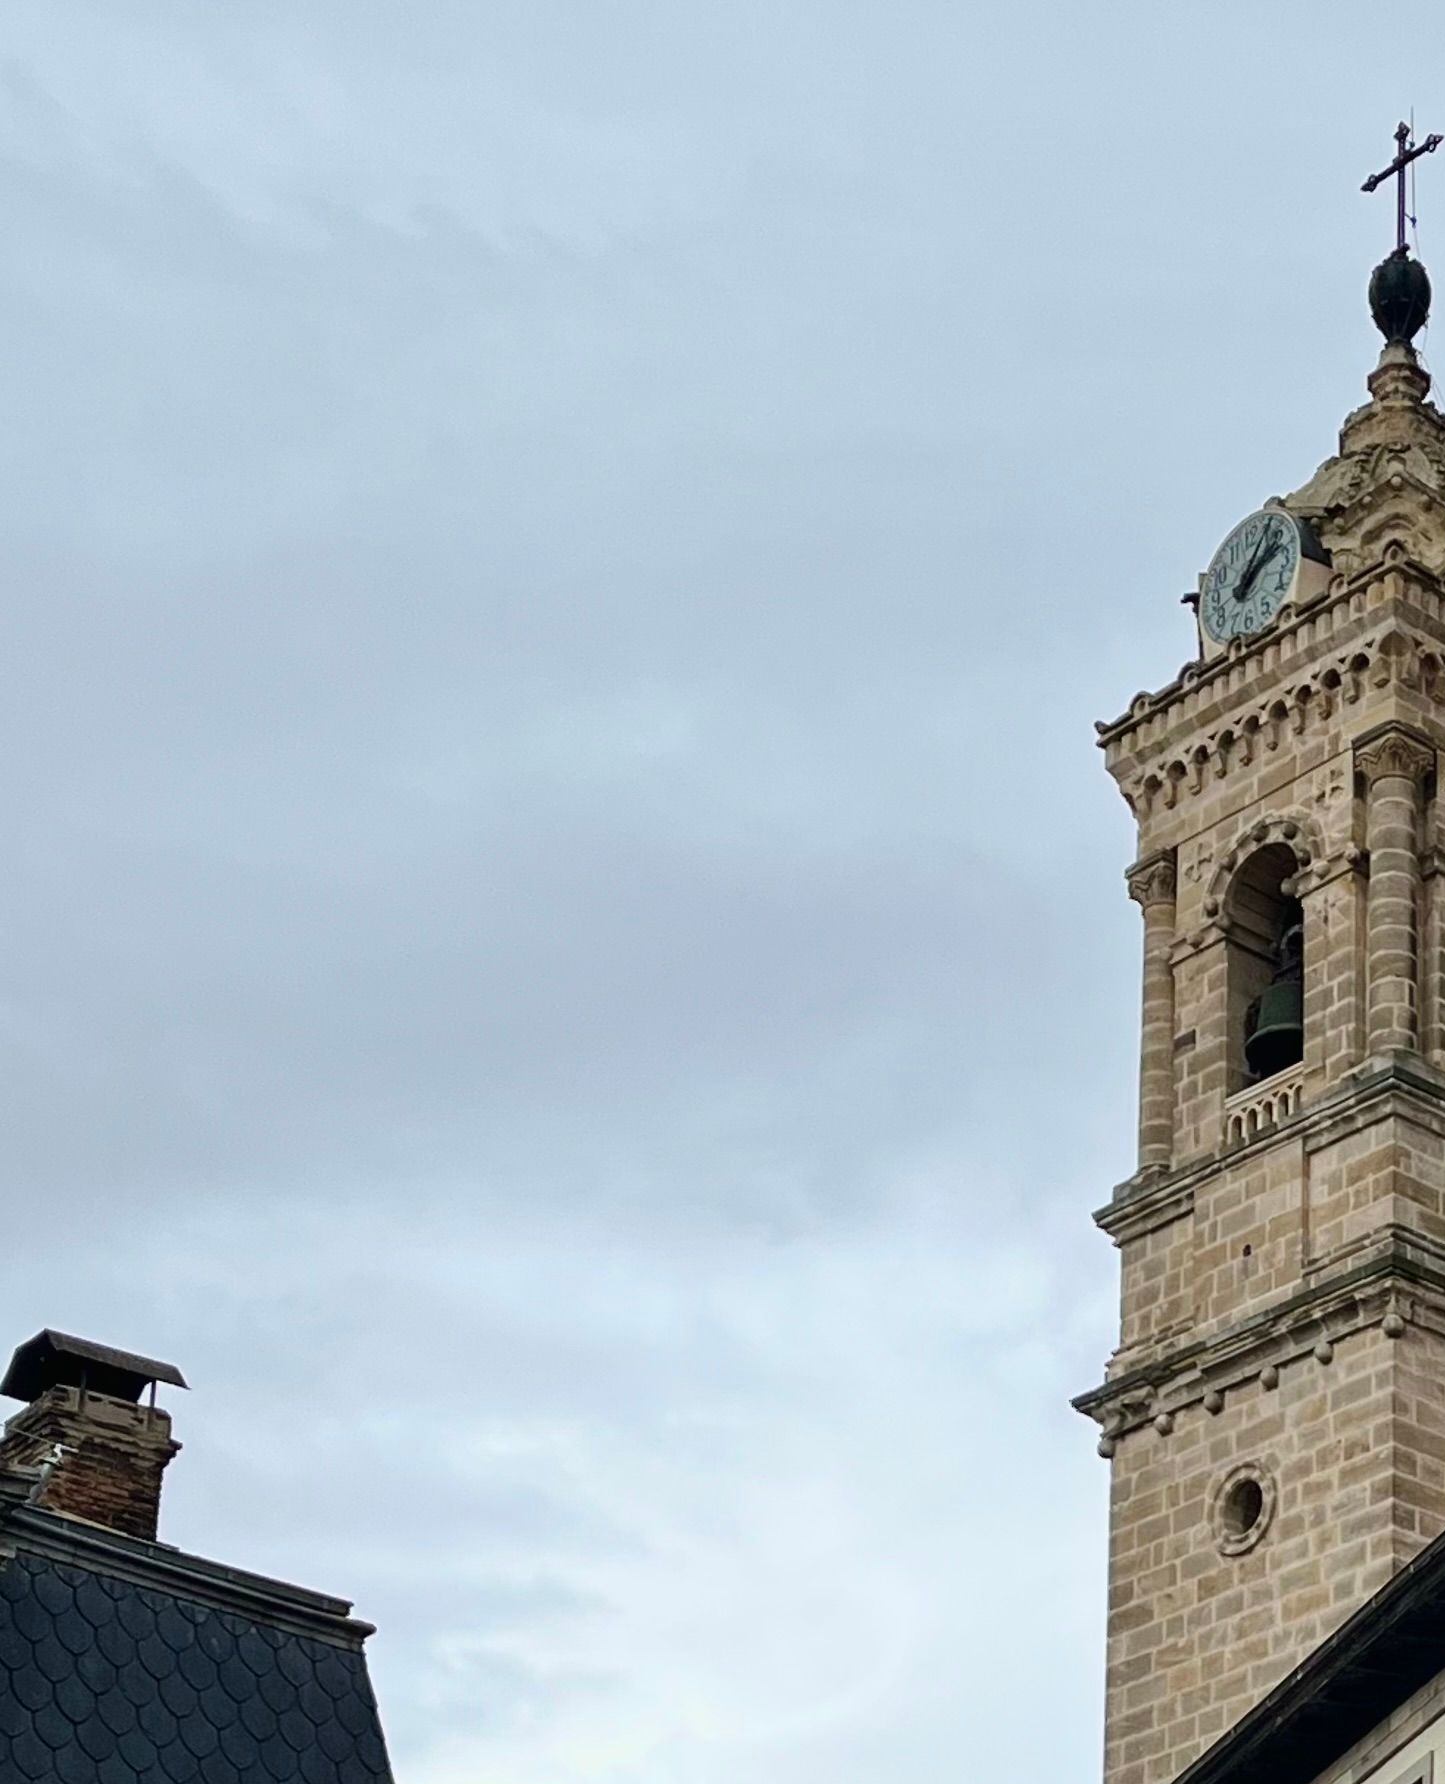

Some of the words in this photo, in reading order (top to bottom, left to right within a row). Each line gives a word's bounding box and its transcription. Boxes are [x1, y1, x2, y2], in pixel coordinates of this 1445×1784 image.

[1245, 525, 1258, 550] 12
[1216, 605, 1226, 628] 8
[1244, 609, 1253, 629] 6
